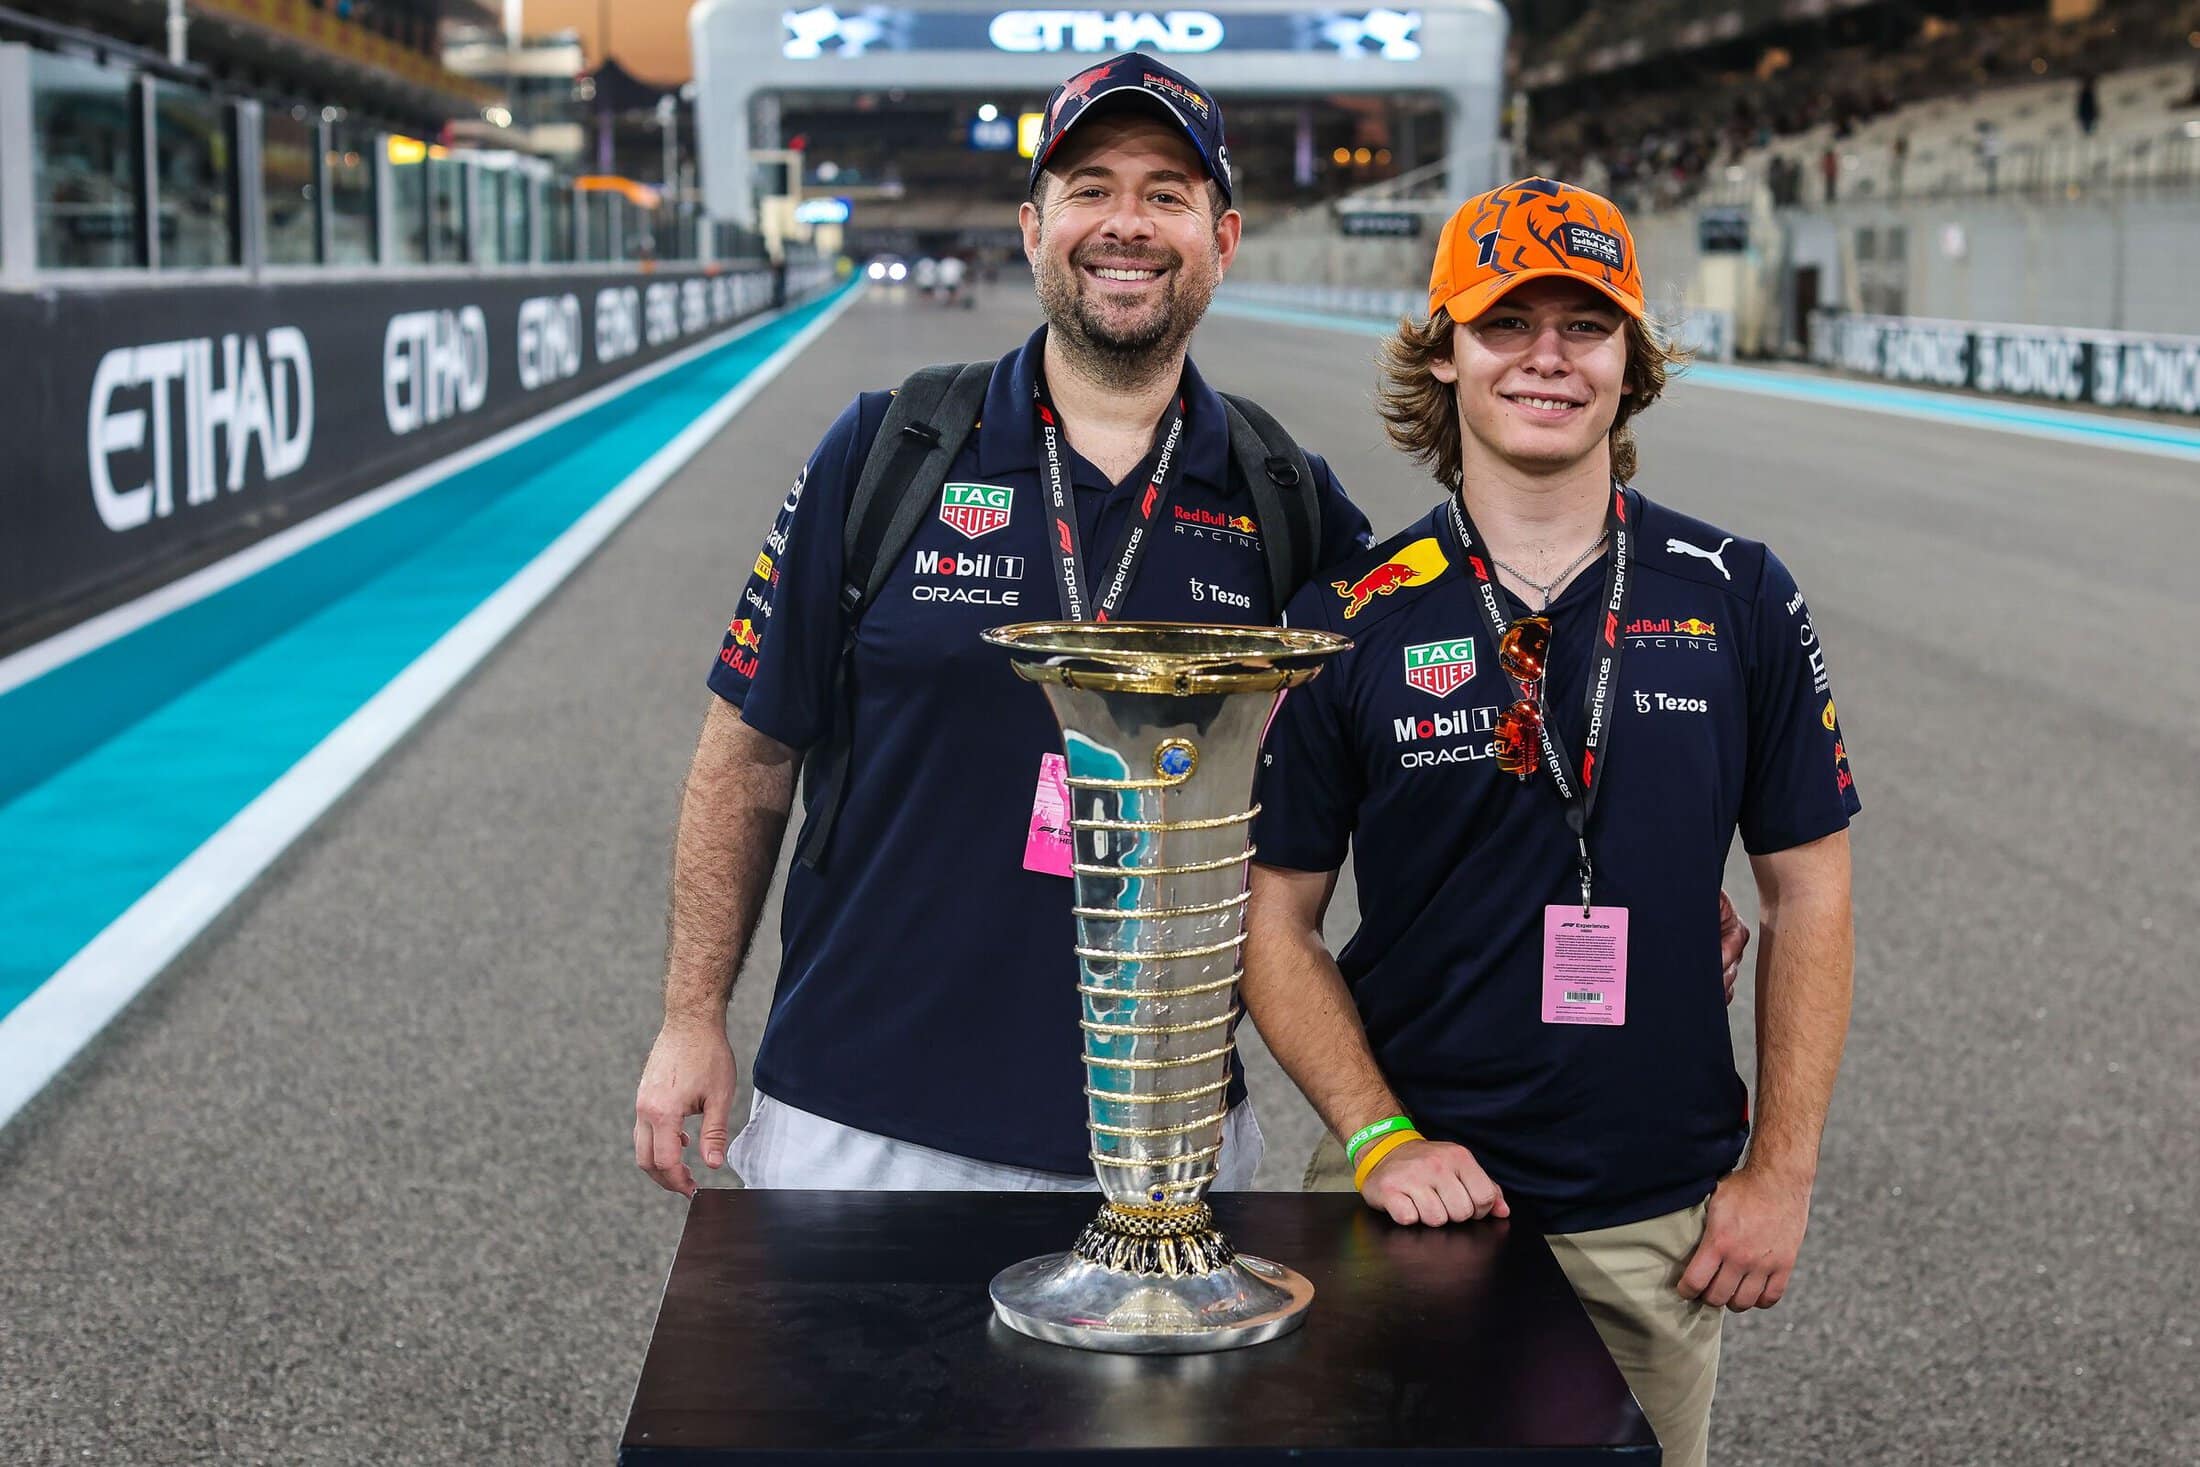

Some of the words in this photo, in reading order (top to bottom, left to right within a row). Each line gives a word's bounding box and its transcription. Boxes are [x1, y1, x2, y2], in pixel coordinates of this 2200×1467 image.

[988, 9, 1226, 53] ETIHAD
[1476, 229, 1501, 269] 1
[1571, 228, 1616, 248] ORACLE
[383, 305, 489, 436] ETIHAD
[88, 326, 315, 532] ETIHAD
[1152, 417, 1183, 485] Experiences
[1044, 426, 1064, 508] Experiences
[950, 487, 1006, 507] TAG
[944, 507, 1006, 535] HEUER
[1174, 505, 1200, 522] Red
[1201, 511, 1225, 527] Bull
[914, 550, 991, 578] Mobil
[1103, 527, 1143, 610] Experiences
[1609, 531, 1626, 611] Experiences
[912, 586, 1020, 606] ORACLE
[1062, 556, 1082, 622] Experien
[1209, 584, 1250, 608] Tezos
[1480, 583, 1507, 635] Experie
[1625, 619, 1641, 634] ed
[1642, 619, 1670, 633] Bull
[1411, 643, 1468, 665] TAG
[1635, 639, 1718, 652] ACING
[1410, 665, 1471, 693] HEUER
[1586, 657, 1611, 748] Experiences
[1654, 693, 1708, 713] Tezos
[1393, 709, 1469, 743] Mobil
